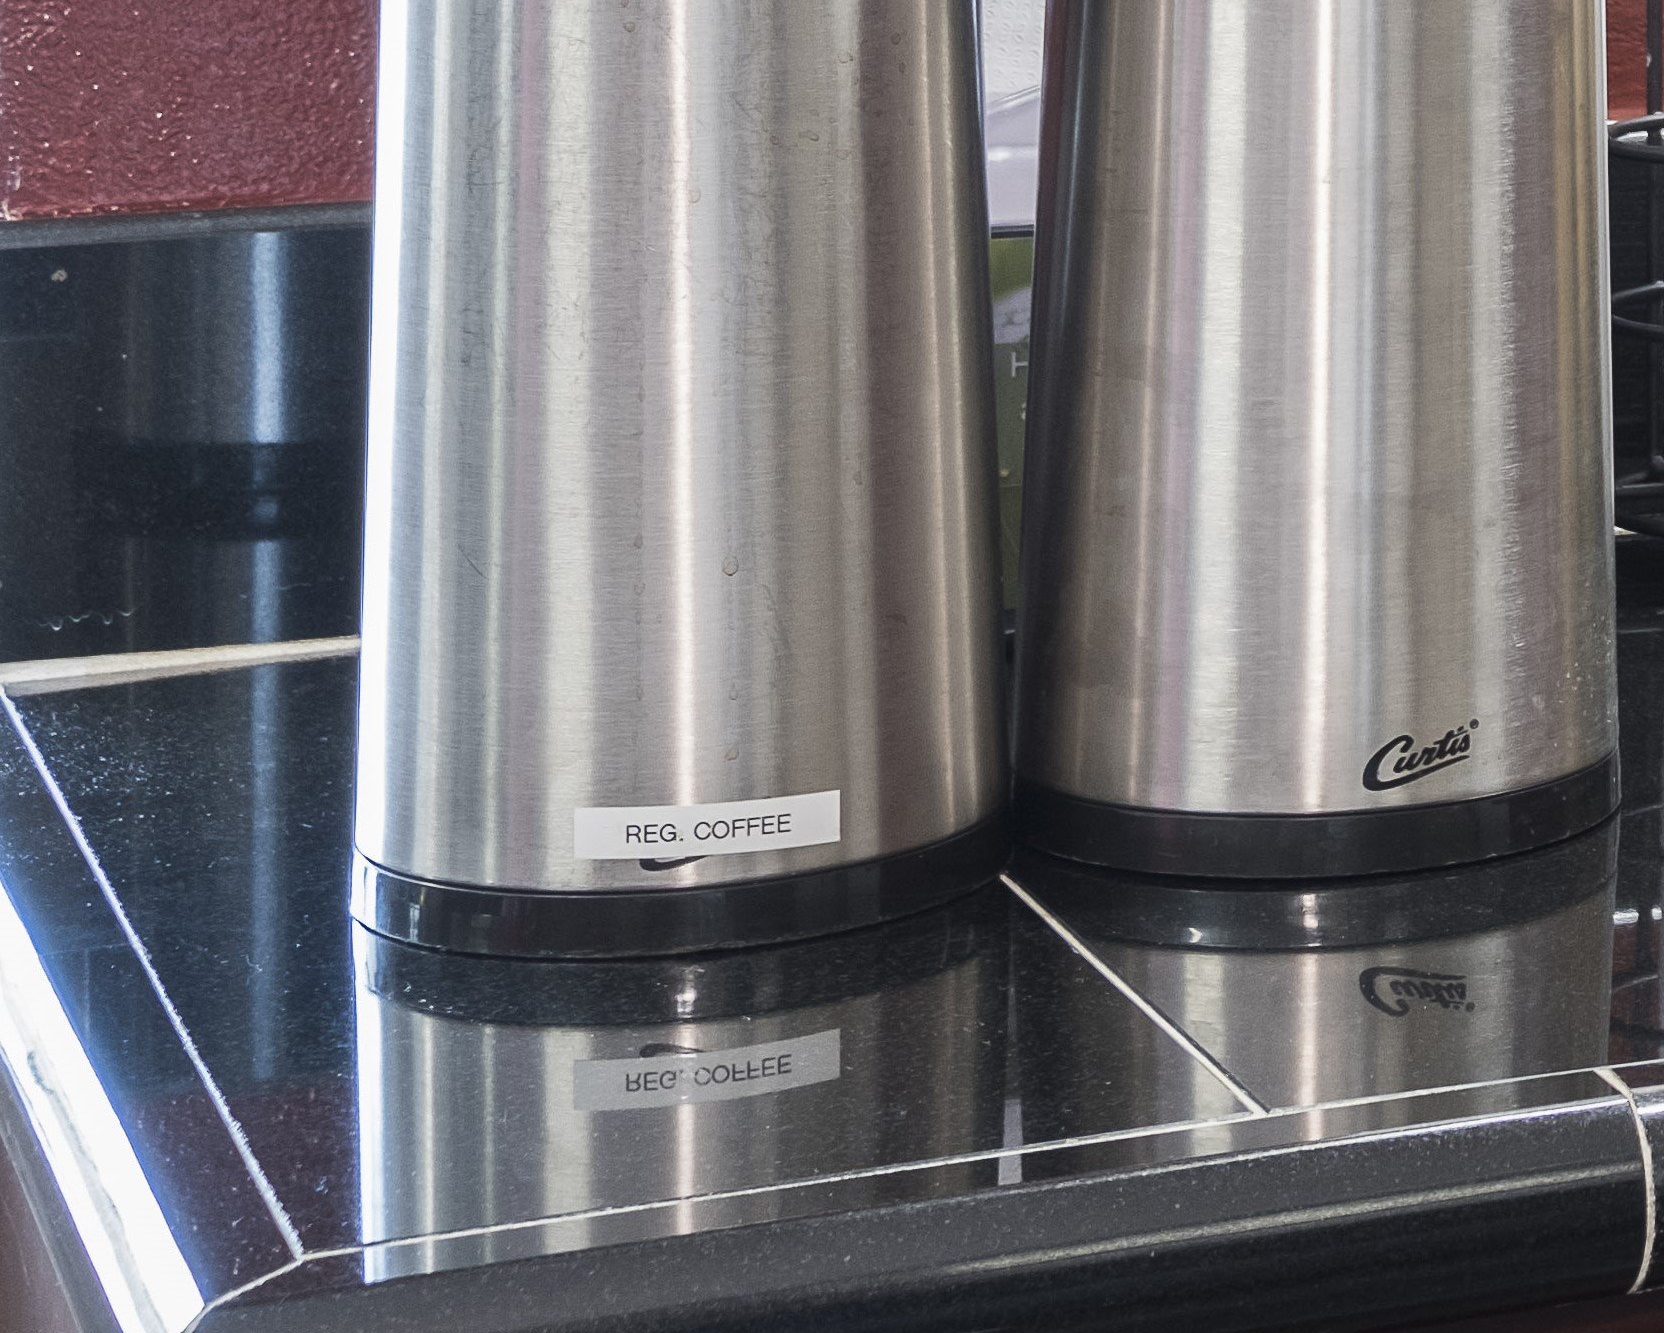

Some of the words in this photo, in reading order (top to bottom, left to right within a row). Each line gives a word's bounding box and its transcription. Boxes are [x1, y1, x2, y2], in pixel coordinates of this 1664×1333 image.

[1362, 725, 1471, 792] Curtis
[625, 822, 684, 845] REG.
[694, 813, 792, 842] COFFEE
